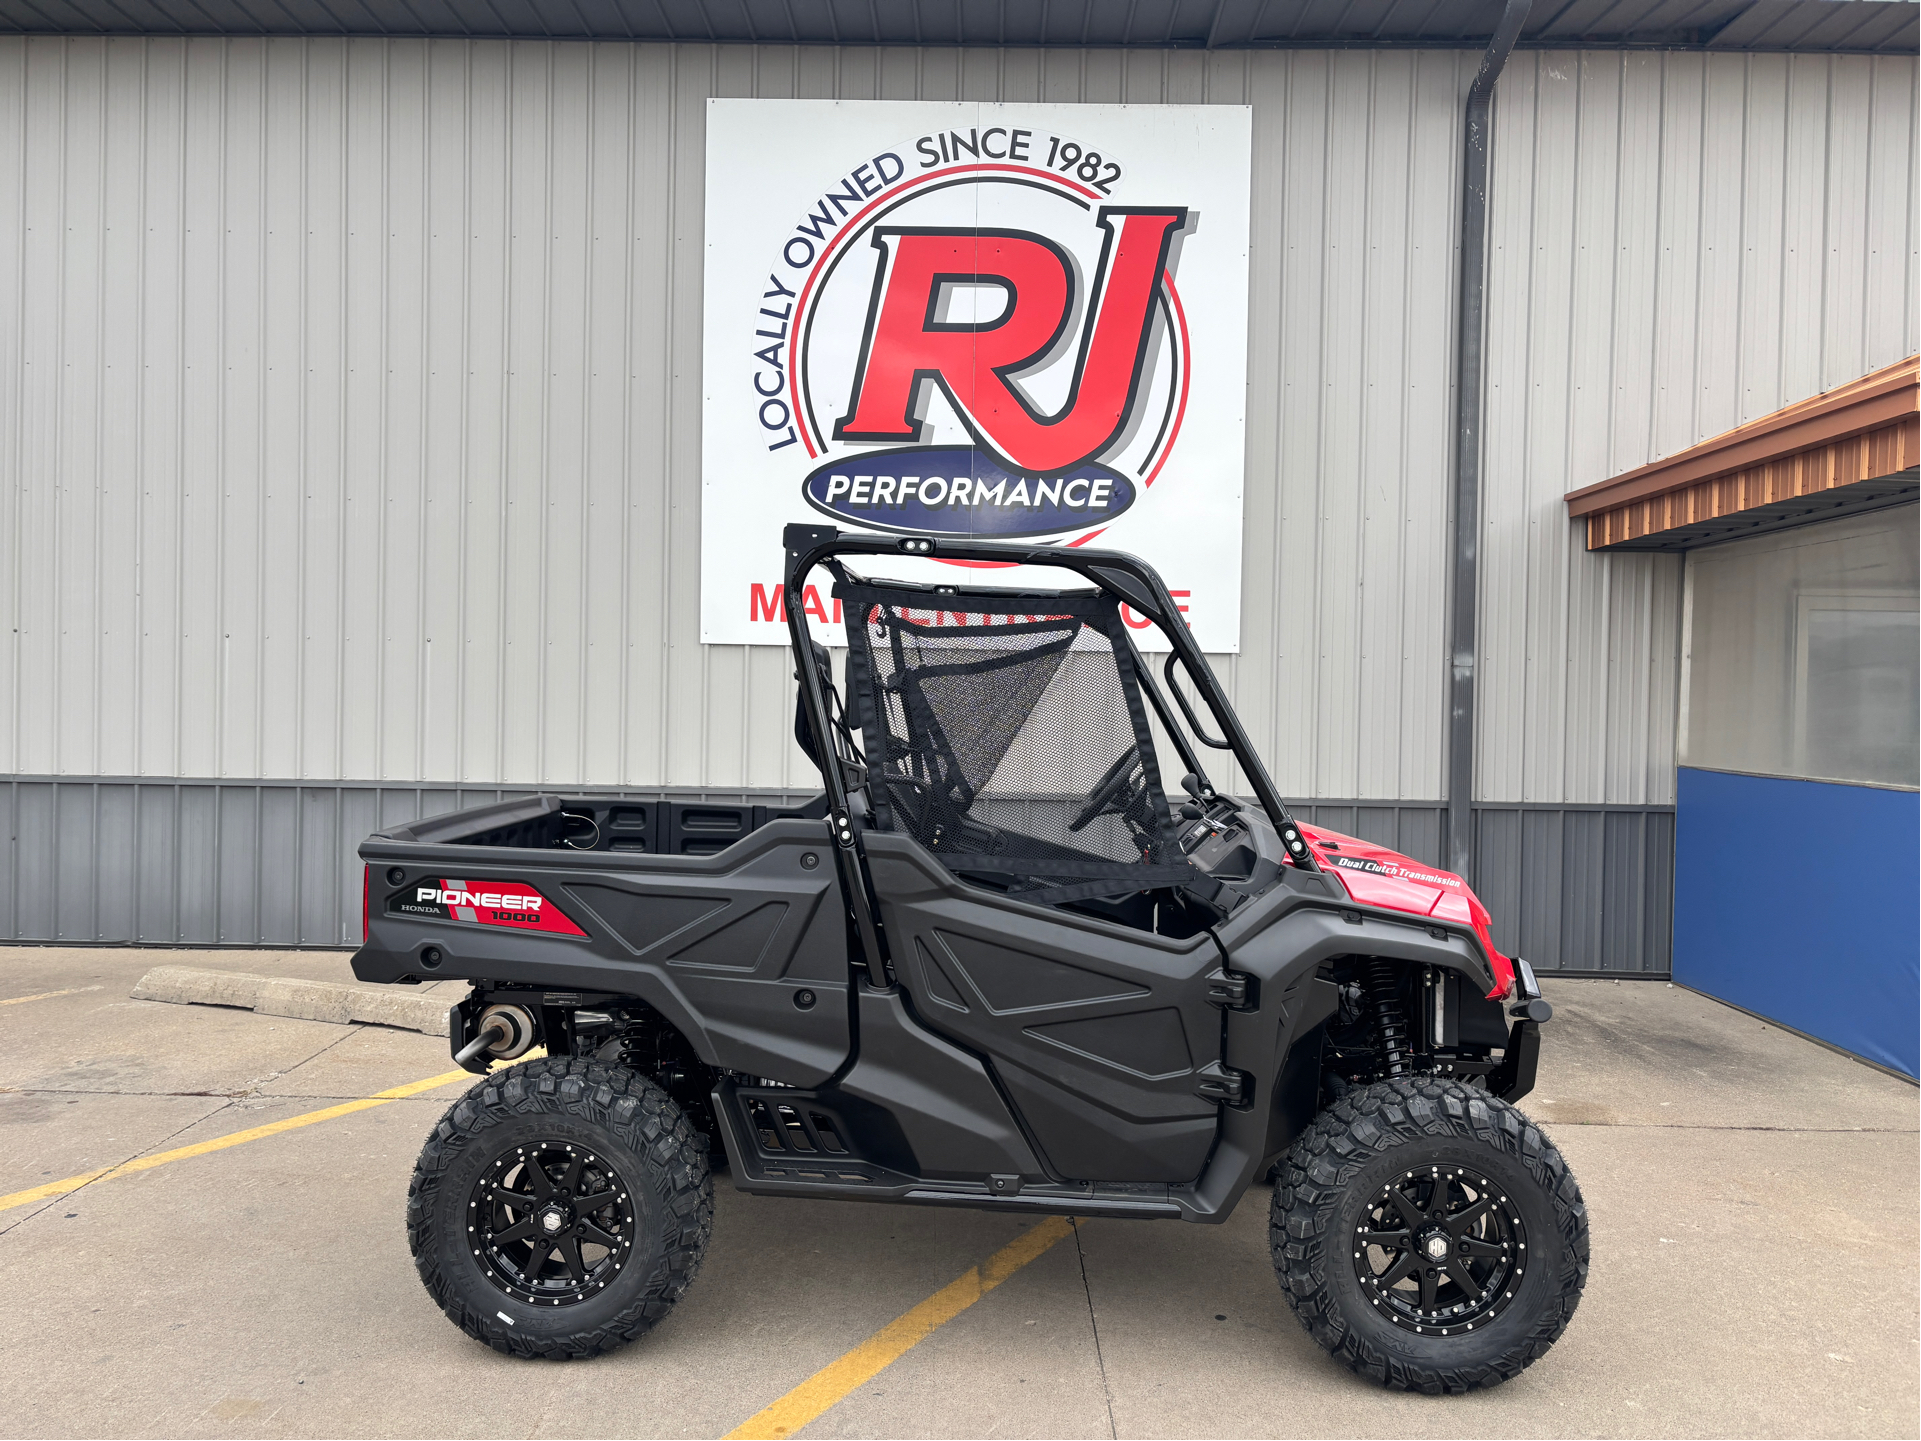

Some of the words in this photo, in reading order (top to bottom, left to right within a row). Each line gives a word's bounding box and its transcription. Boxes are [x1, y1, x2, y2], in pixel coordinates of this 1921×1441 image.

[753, 273, 798, 451] LOCALLY
[783, 151, 905, 269] OWNED
[915, 128, 1032, 169] SINCE
[1045, 136, 1122, 195] 1982
[832, 206, 1189, 478] RJ
[825, 475, 1113, 508] PERFORMANCE
[1338, 857, 1364, 869] Dual
[1364, 862, 1398, 875] Clutch
[1399, 868, 1461, 888] Transmission
[401, 904, 441, 914] HONDA
[416, 887, 542, 911] PIONEER
[491, 910, 541, 923] 1000
